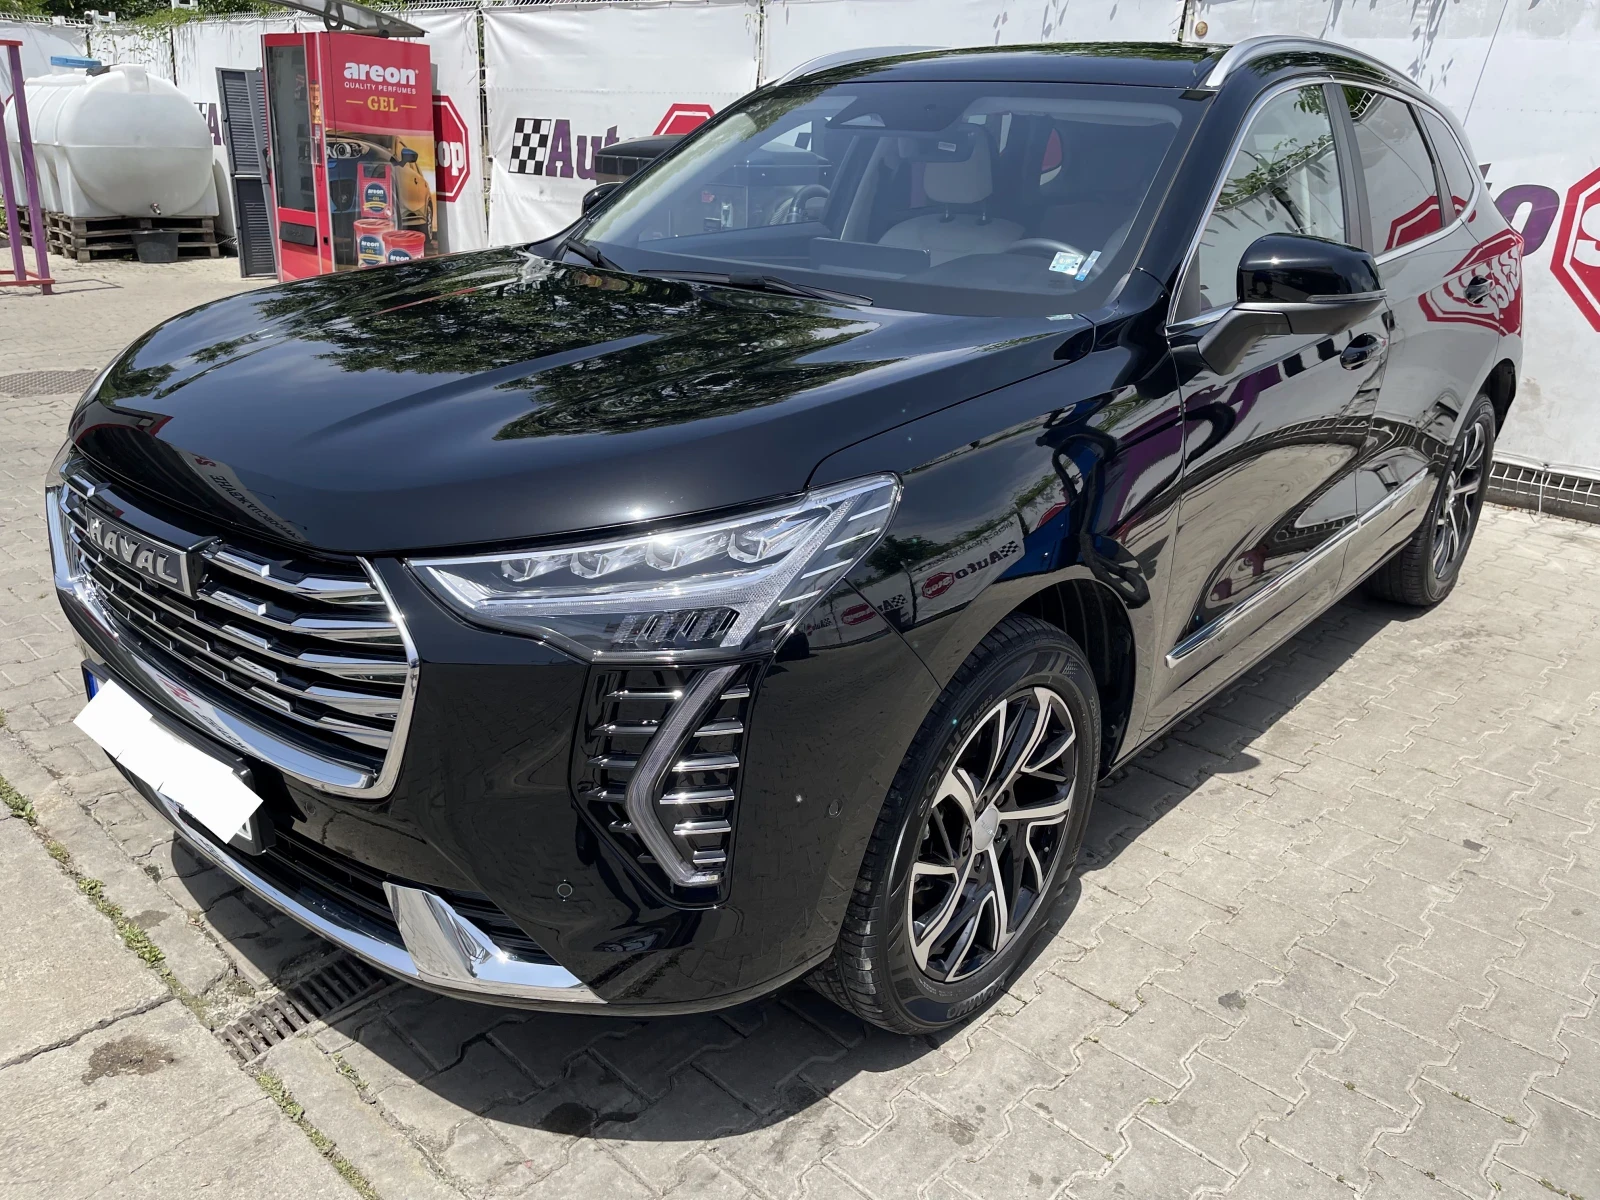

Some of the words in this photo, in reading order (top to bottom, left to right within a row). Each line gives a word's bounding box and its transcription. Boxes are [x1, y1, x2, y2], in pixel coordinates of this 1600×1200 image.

[343, 62, 416, 85] areon
[344, 81, 376, 91] QUALITY
[378, 85, 417, 95] PERFUMES
[367, 95, 399, 112] GEL
[88, 516, 178, 585] HAVAL
[917, 713, 973, 818] SOLUS
